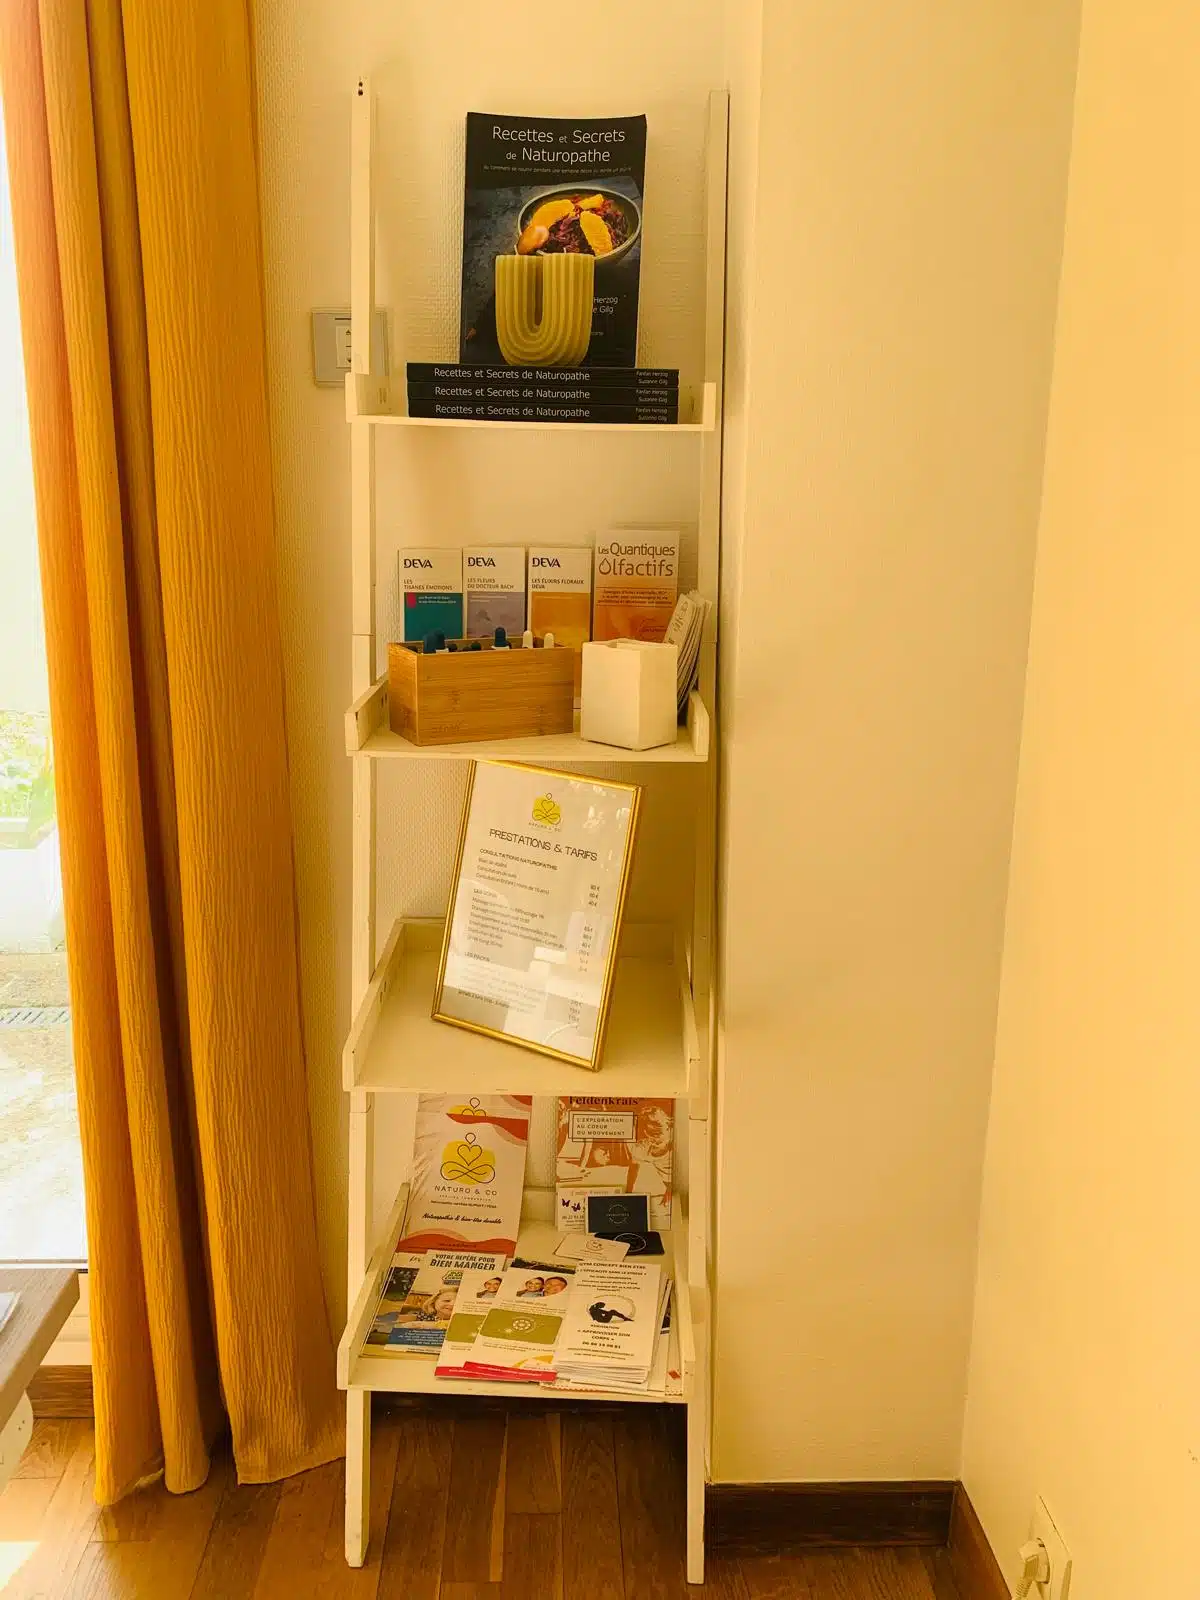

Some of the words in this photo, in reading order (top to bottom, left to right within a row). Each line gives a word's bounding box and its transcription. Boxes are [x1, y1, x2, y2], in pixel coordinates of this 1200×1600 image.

[492, 126, 554, 143] Recettes
[558, 135, 568, 143] et
[572, 129, 626, 144] Secrets
[506, 151, 517, 160] de
[522, 147, 611, 165] Naturopathe
[593, 296, 619, 305] Herzog
[599, 305, 614, 315] Gilg
[434, 367, 472, 378] Recettes
[474, 369, 484, 379] et
[486, 368, 519, 380] Secrets
[521, 369, 533, 380] de
[535, 370, 590, 382] Naturopathe
[435, 386, 472, 396] Recettes
[475, 388, 484, 397] et
[487, 387, 520, 398] Secrets
[522, 388, 533, 398] de
[535, 389, 590, 401] Naturopathe
[435, 404, 472, 414] Recettes
[475, 406, 484, 414] et
[487, 405, 520, 416] Secrets
[522, 406, 533, 416] de
[535, 407, 590, 418] Naturopathe
[610, 542, 675, 559] Quantiques
[403, 559, 433, 568] DEVA
[467, 557, 496, 567] DEVA
[532, 557, 561, 568] DEVA
[598, 557, 674, 577] Olfactifs
[489, 828, 551, 851] PRESTATIONS
[554, 844, 563, 853] &
[565, 846, 598, 862] TARIFS
[479, 849, 519, 862] CONSULTATIONS
[569, 1096, 639, 1106] Feldenkrais
[434, 1185, 471, 1194] NATURO
[429, 1258, 453, 1268] BIEN
[454, 1260, 496, 1271] MANGER
[435, 1253, 453, 1261] VOTRE
[478, 1255, 496, 1263] POUR
